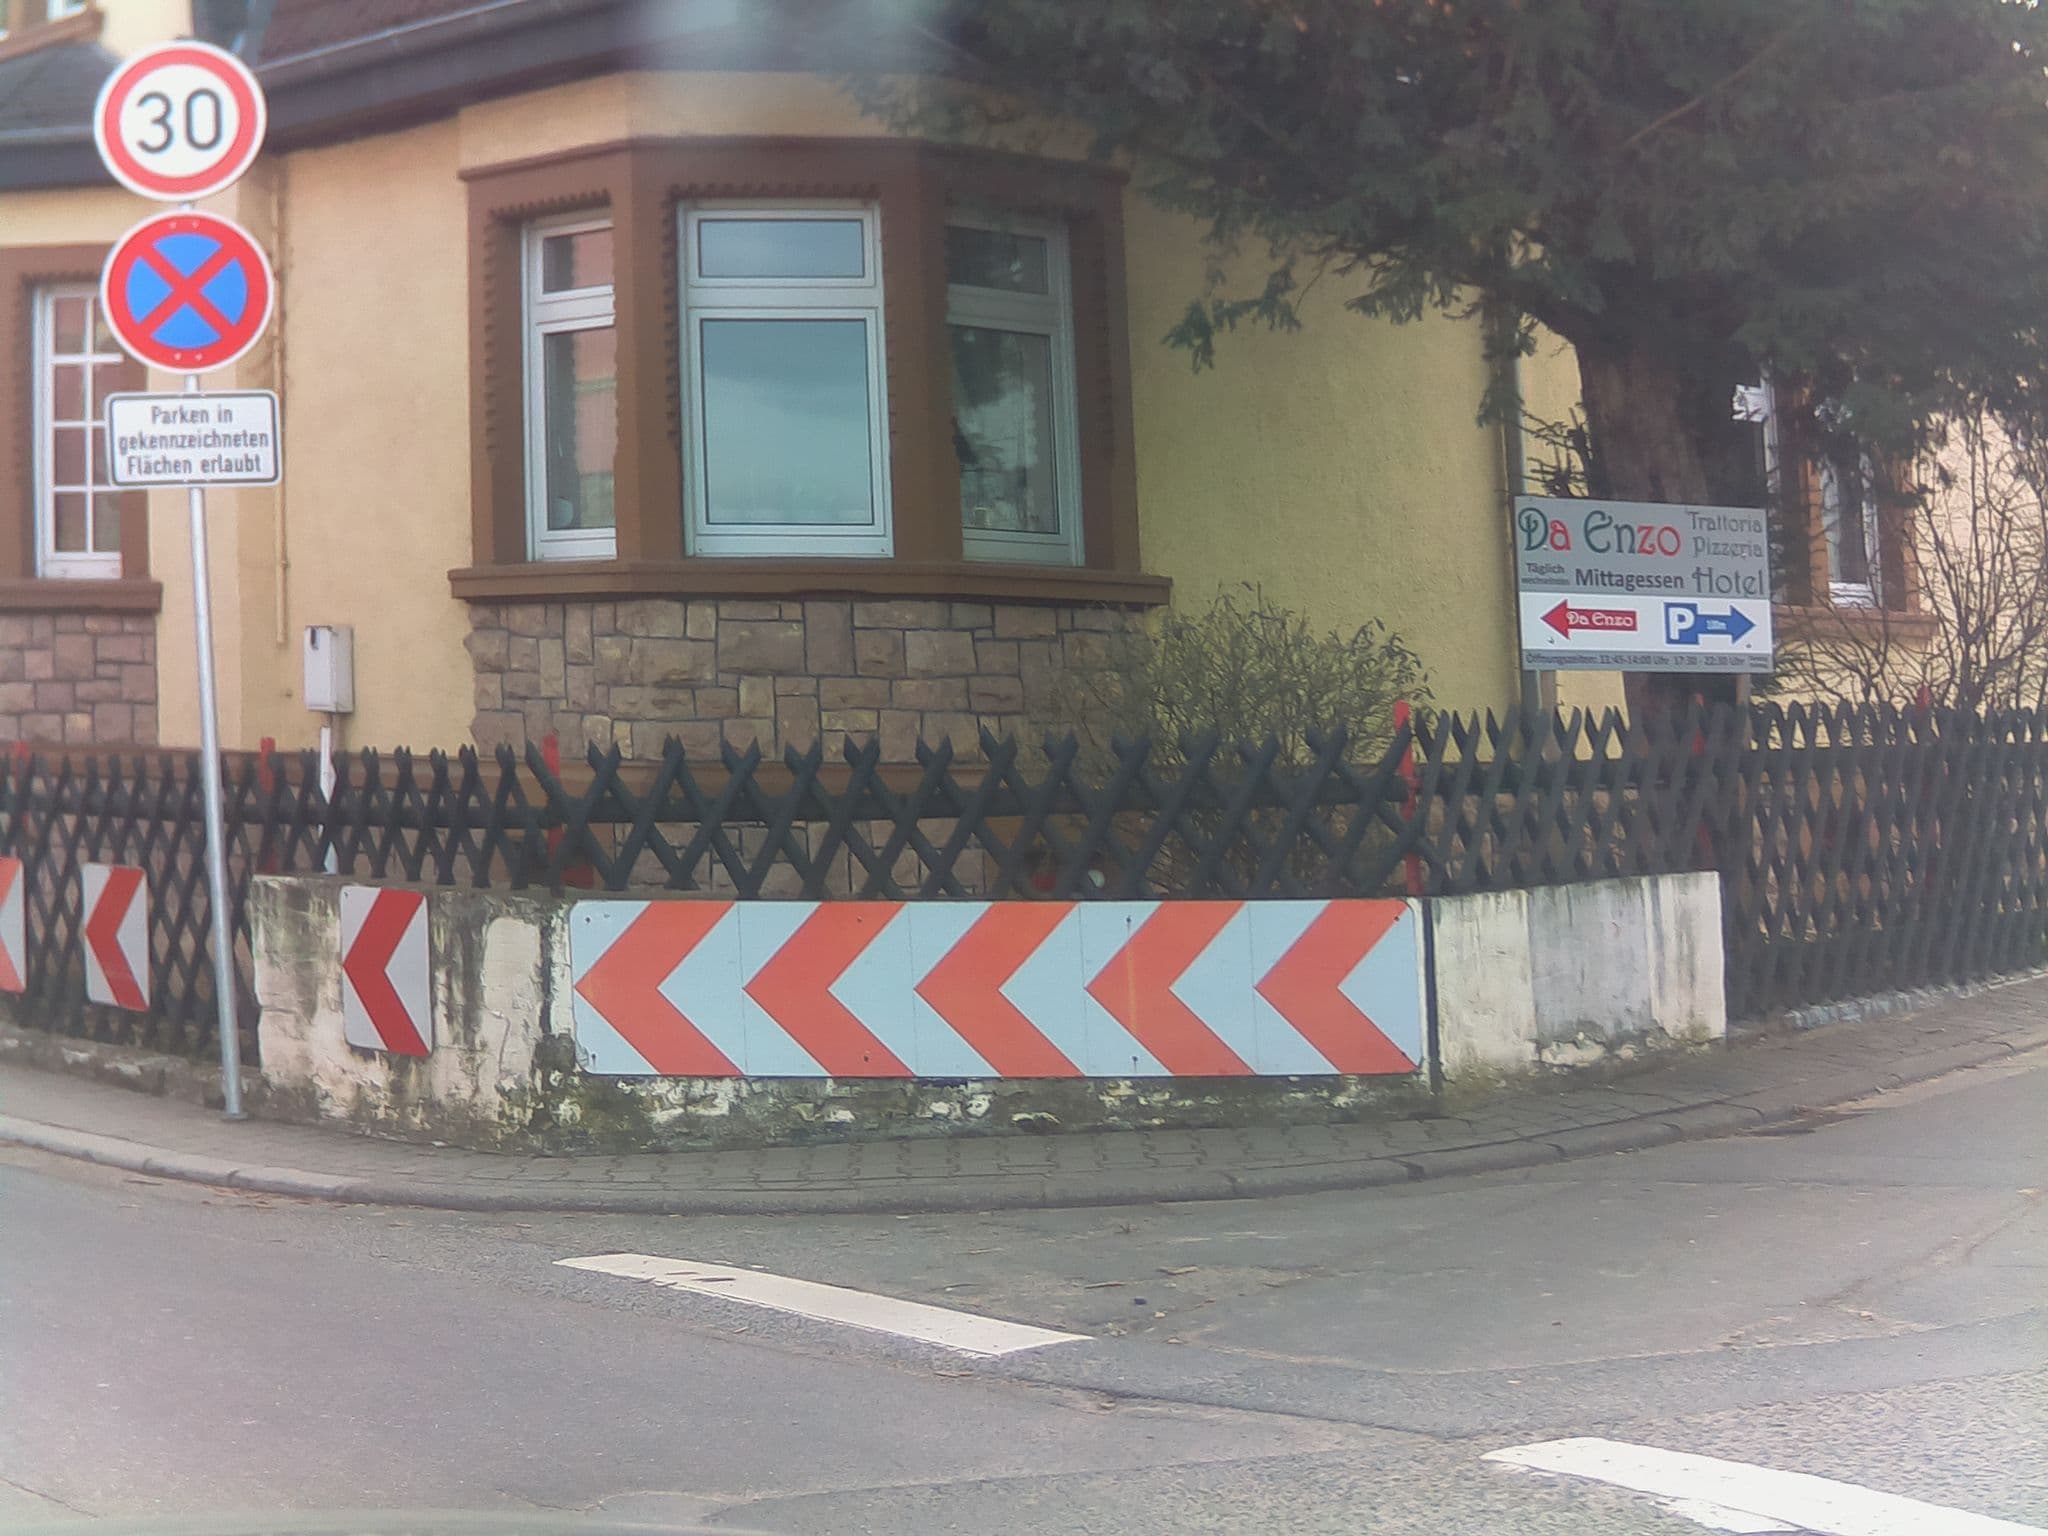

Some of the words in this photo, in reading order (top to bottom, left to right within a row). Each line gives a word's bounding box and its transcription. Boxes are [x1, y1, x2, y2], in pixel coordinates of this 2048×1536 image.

[135, 87, 223, 155] 30
[151, 405, 209, 424] Parken
[217, 403, 233, 423] in
[118, 428, 269, 455] gekennzeichneten
[127, 455, 192, 475] Flächen
[201, 453, 261, 473] erlaubt
[1518, 507, 1572, 552] Da
[1583, 510, 1682, 557] Enzo
[1687, 511, 1763, 534] Trattoria
[1693, 536, 1764, 559] Pizzeria
[1526, 562, 1565, 575] Täglich
[1575, 568, 1684, 592] Mittagessen
[1692, 566, 1765, 595] Hotel
[1567, 611, 1589, 626] Da
[1592, 612, 1634, 627] Enzo
[1668, 607, 1696, 640] P
